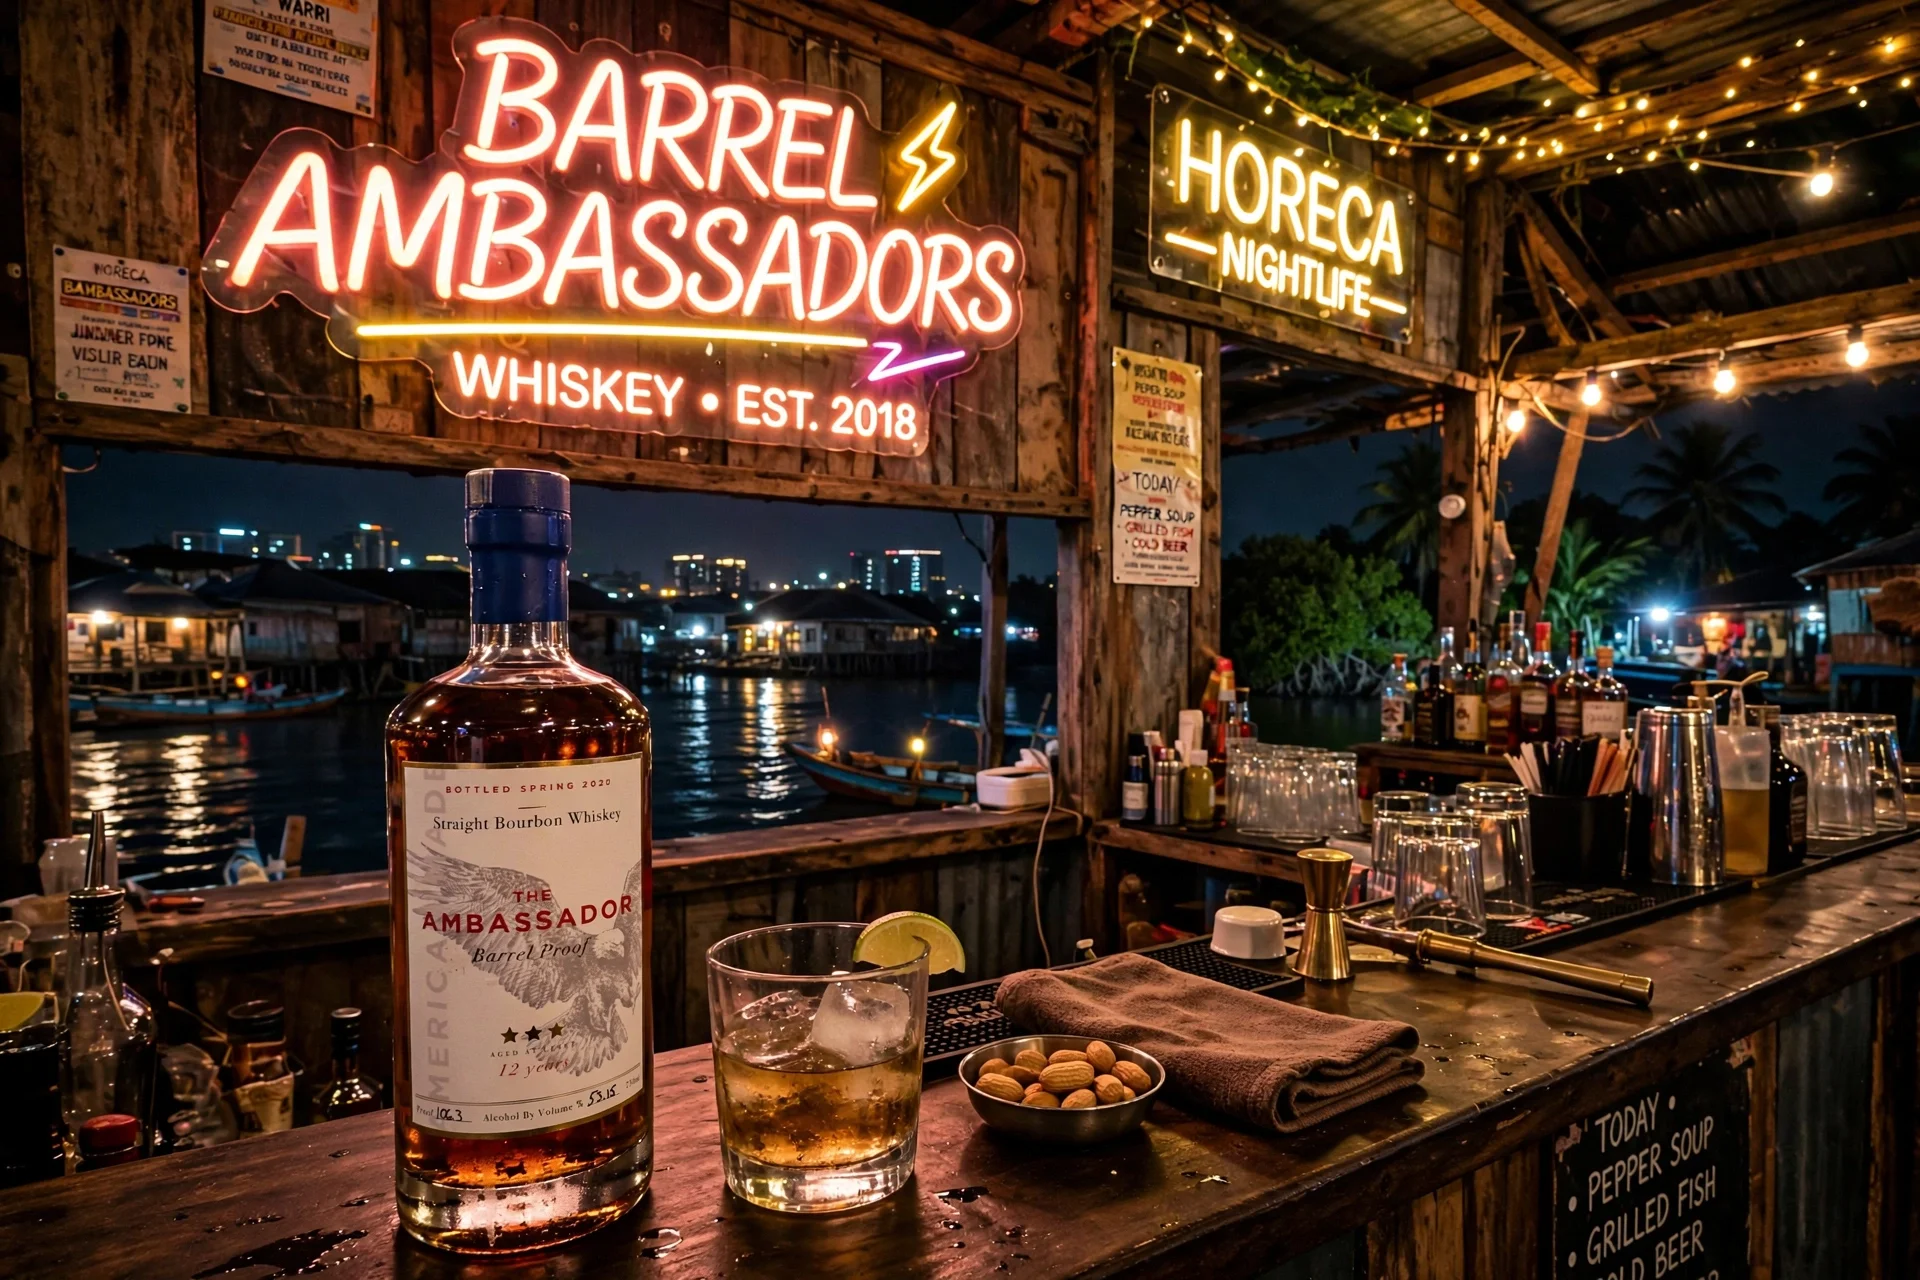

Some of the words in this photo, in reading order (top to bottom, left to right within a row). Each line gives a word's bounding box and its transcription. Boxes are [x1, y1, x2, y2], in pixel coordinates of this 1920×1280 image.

[279, 0, 330, 23] WARRI
[464, 37, 878, 210] BARREL
[1177, 118, 1404, 276] HORECA
[230, 150, 1015, 335] AMBASSADORS
[1221, 231, 1372, 318] NIGHTLIFE
[453, 350, 685, 417] WHISKEY
[736, 383, 818, 433] EST.
[831, 396, 917, 441] 2018
[1120, 503, 1161, 521] PEPPER
[1166, 509, 1195, 523] SOUP
[445, 784, 511, 794] BOTTLED
[520, 782, 575, 793] SPRING
[582, 778, 612, 789] 2020
[433, 816, 489, 834] Straight
[495, 815, 563, 830] Bourbon
[568, 808, 622, 825] Whiskey
[422, 895, 632, 934] AMBASSADOR
[513, 889, 551, 903] THE
[472, 944, 534, 963] Barrel
[539, 936, 589, 959] Proof
[490, 1050, 519, 1058] AGED
[499, 1062, 520, 1077] 12
[524, 1058, 568, 1079] years
[483, 1112, 519, 1122] Alcohol
[523, 1111, 534, 1121] By
[538, 1104, 573, 1117] Volume
[576, 1100, 584, 1108] %
[1595, 1092, 1660, 1153] TODAY
[1588, 1142, 1662, 1212] PEPPER
[1670, 1116, 1714, 1167] SOUP
[1586, 1193, 1670, 1265] GRILLED
[1678, 1165, 1716, 1217] FISH
[1655, 1219, 1704, 1279] BEER
